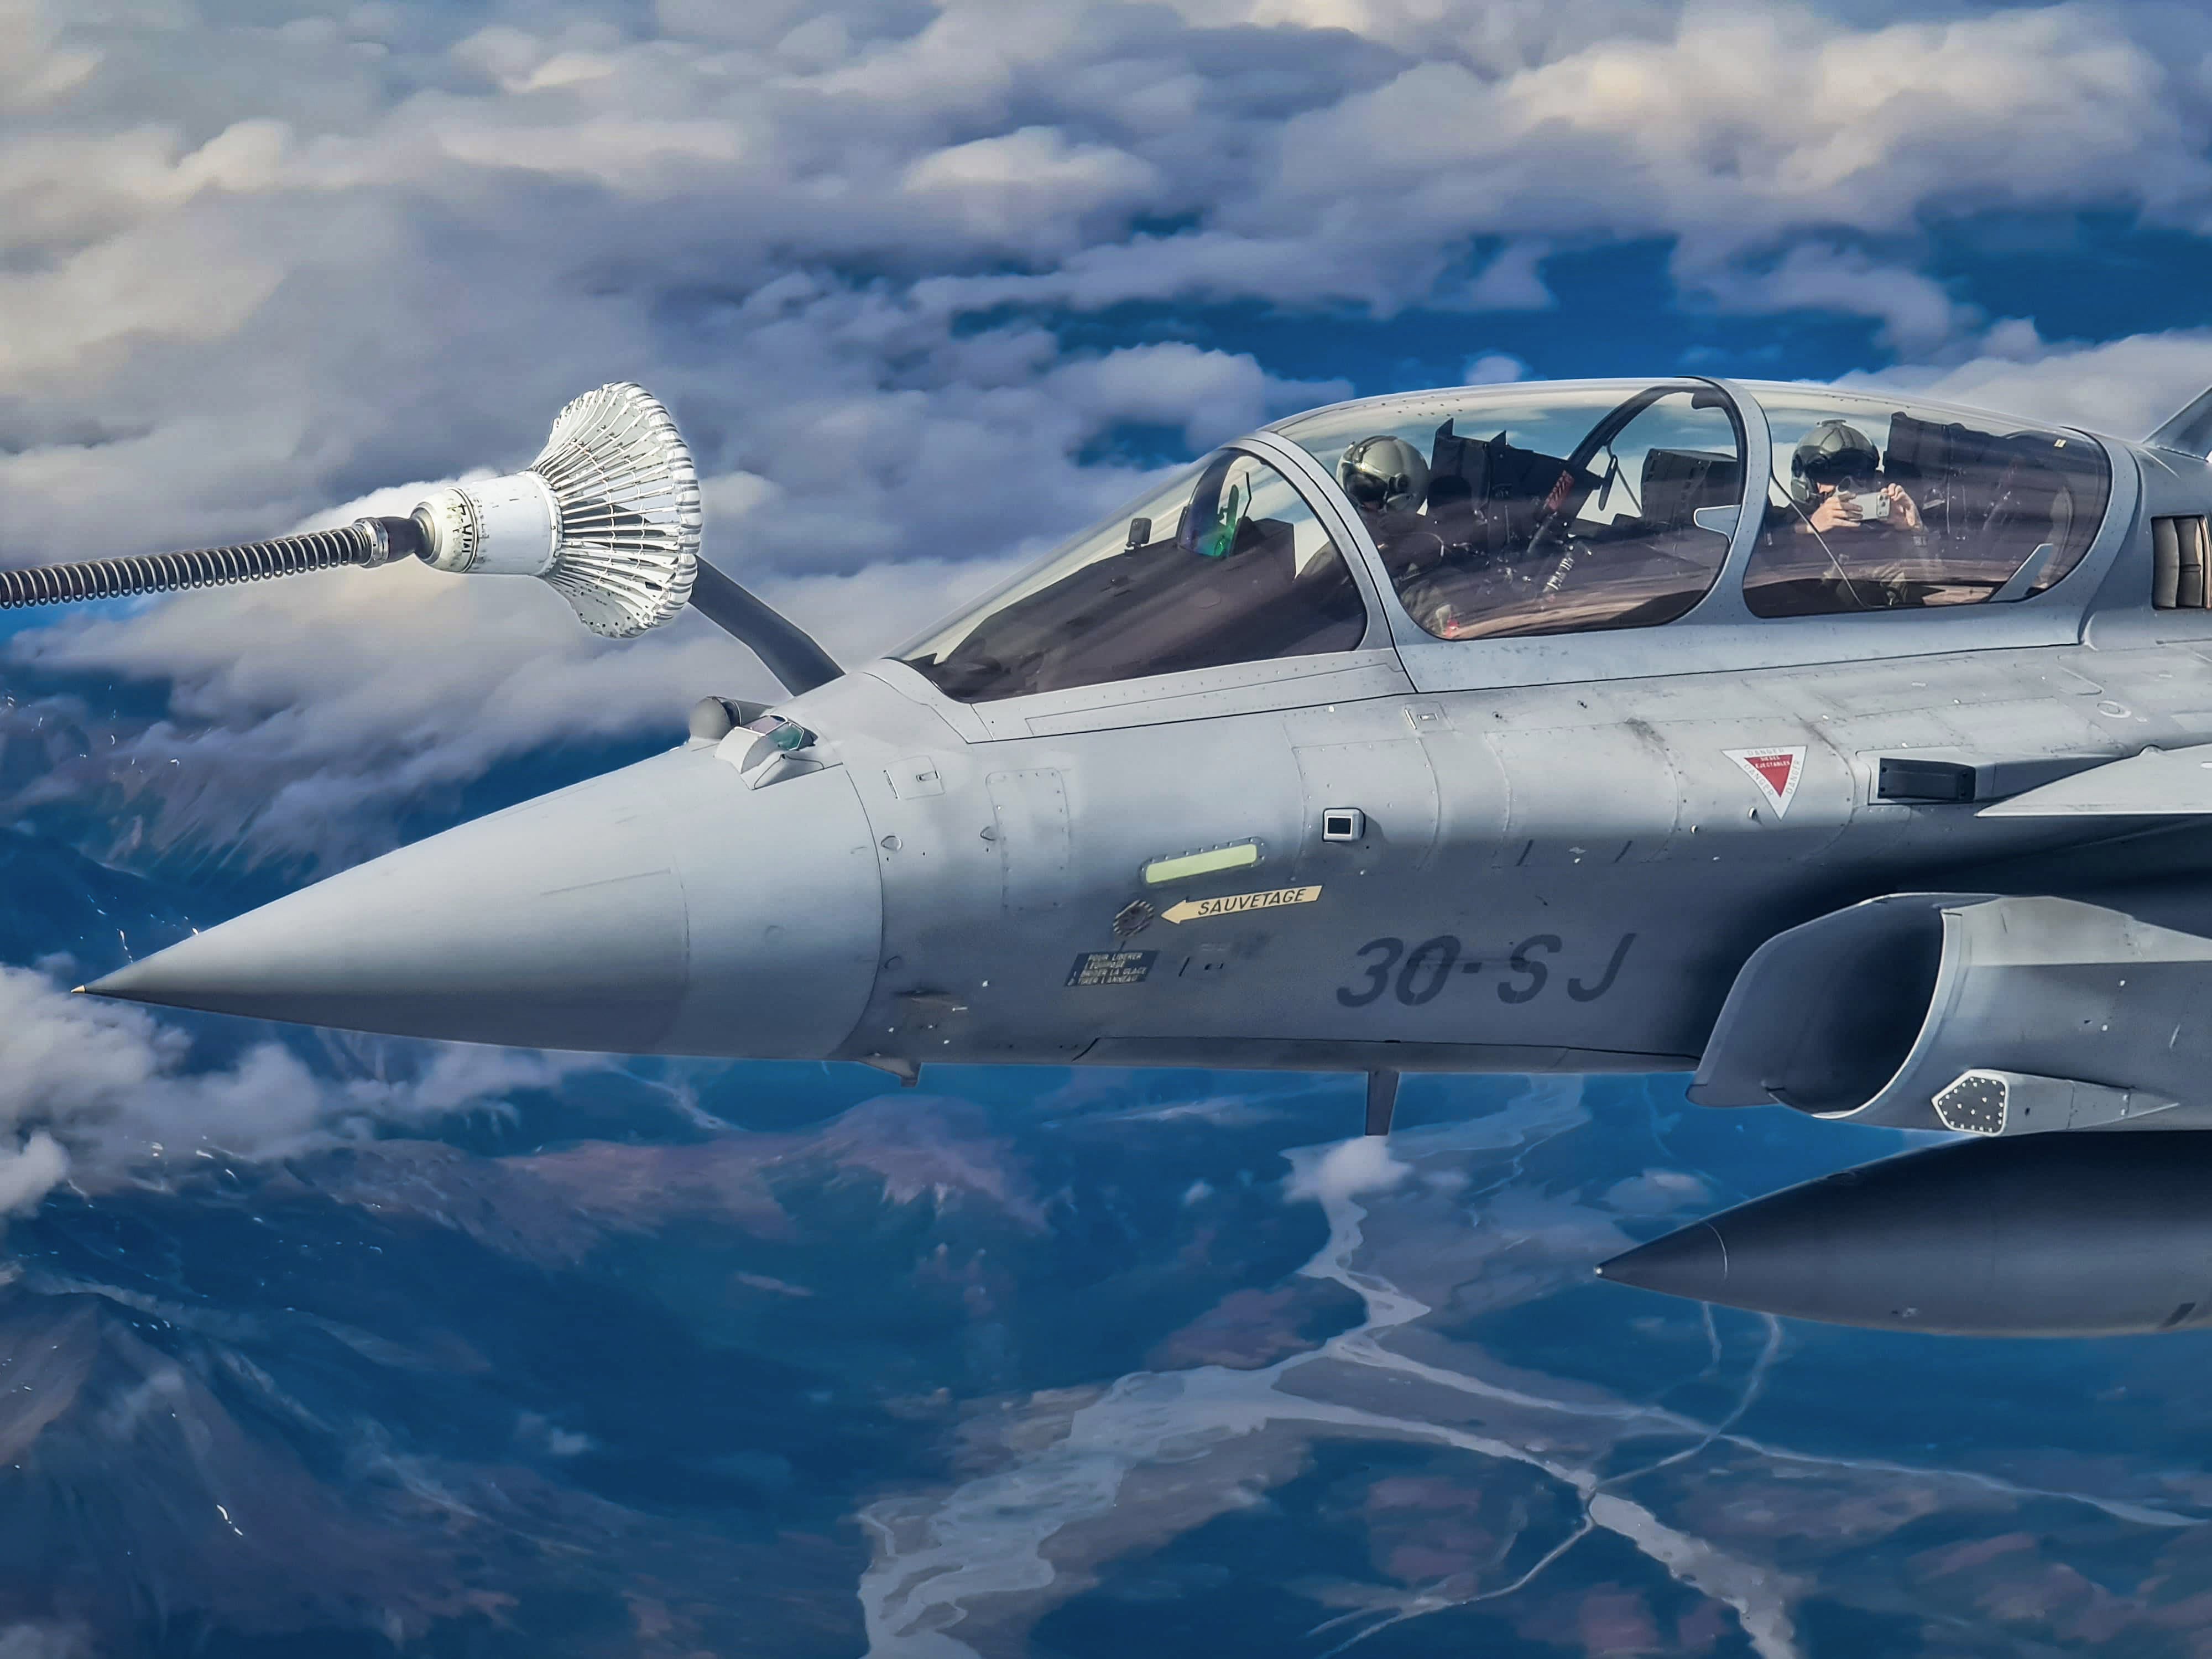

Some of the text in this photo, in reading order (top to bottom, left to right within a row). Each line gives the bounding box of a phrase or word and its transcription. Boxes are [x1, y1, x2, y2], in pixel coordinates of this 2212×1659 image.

[1744, 764, 1774, 796] DANGER
[1786, 760, 1801, 795] DANGER
[1198, 888, 1306, 916] SAUVETAGE
